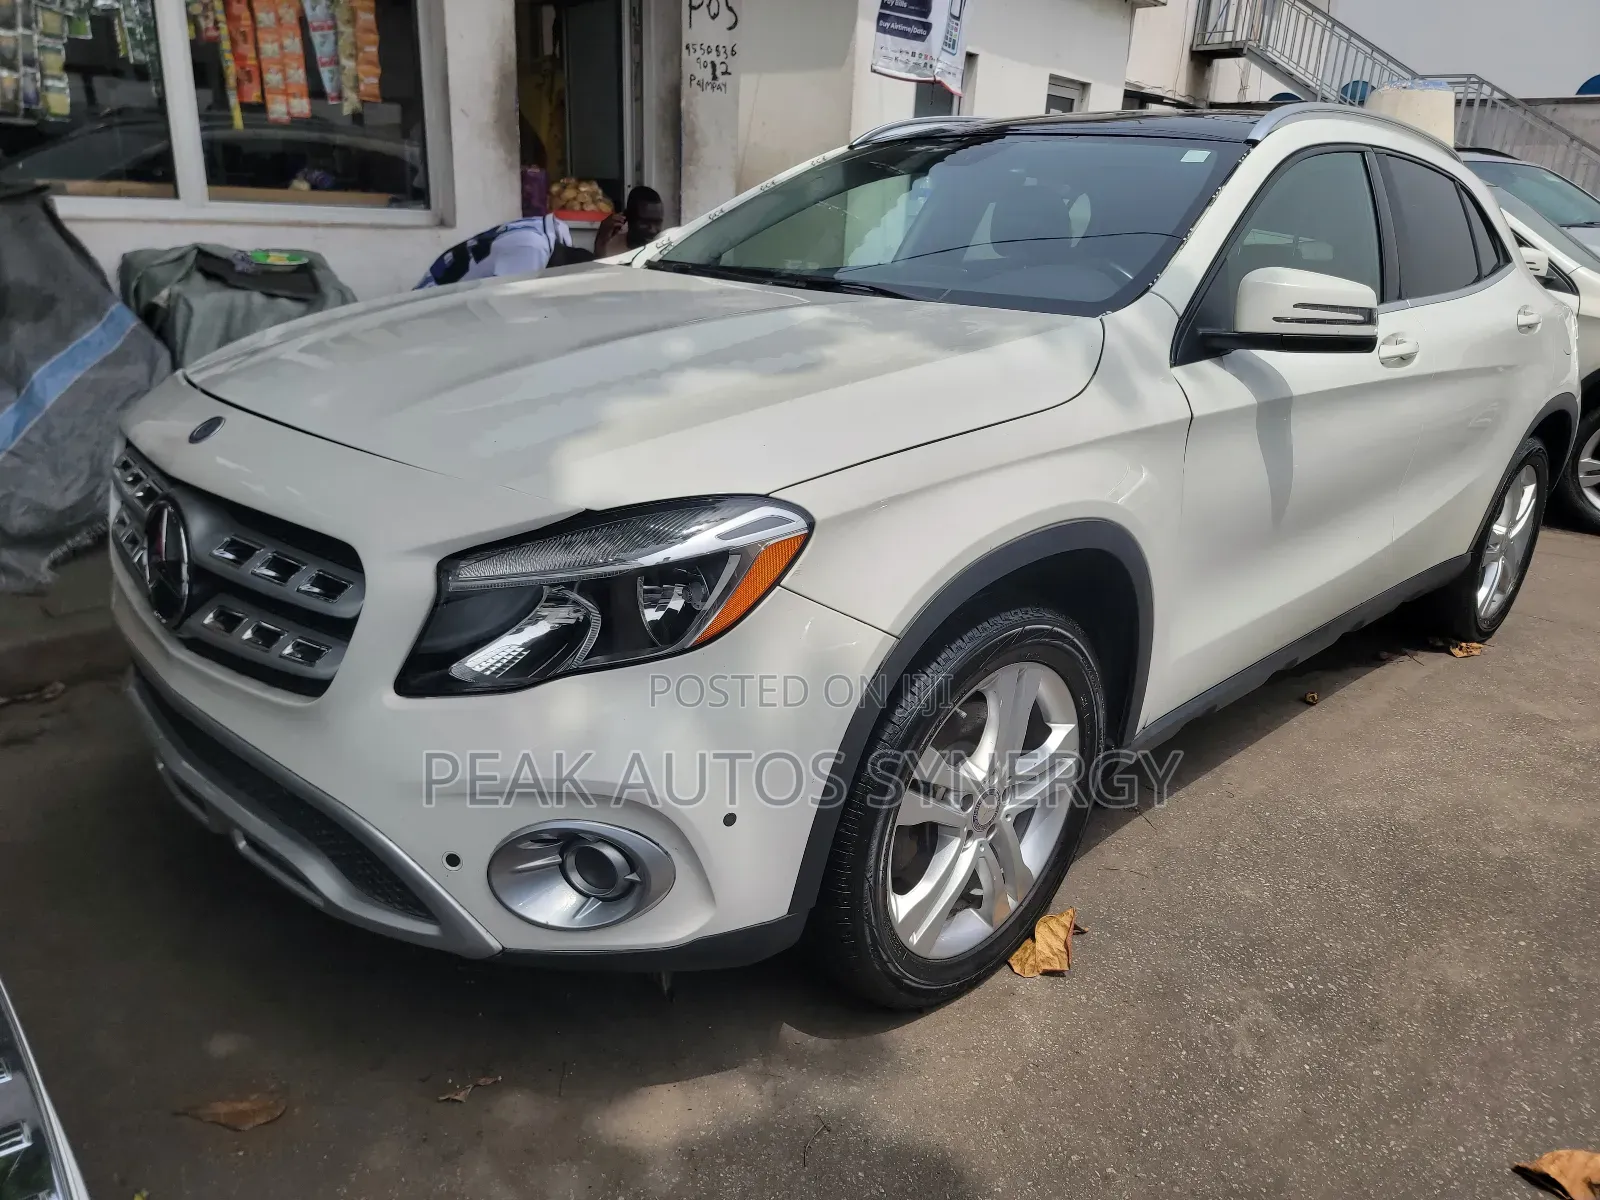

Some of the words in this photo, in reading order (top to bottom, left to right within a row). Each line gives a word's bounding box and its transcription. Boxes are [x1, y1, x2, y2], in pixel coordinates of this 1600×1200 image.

[688, 0, 739, 31] POS
[879, 20, 890, 29] Buy
[890, 22, 926, 35] Airtime/Data
